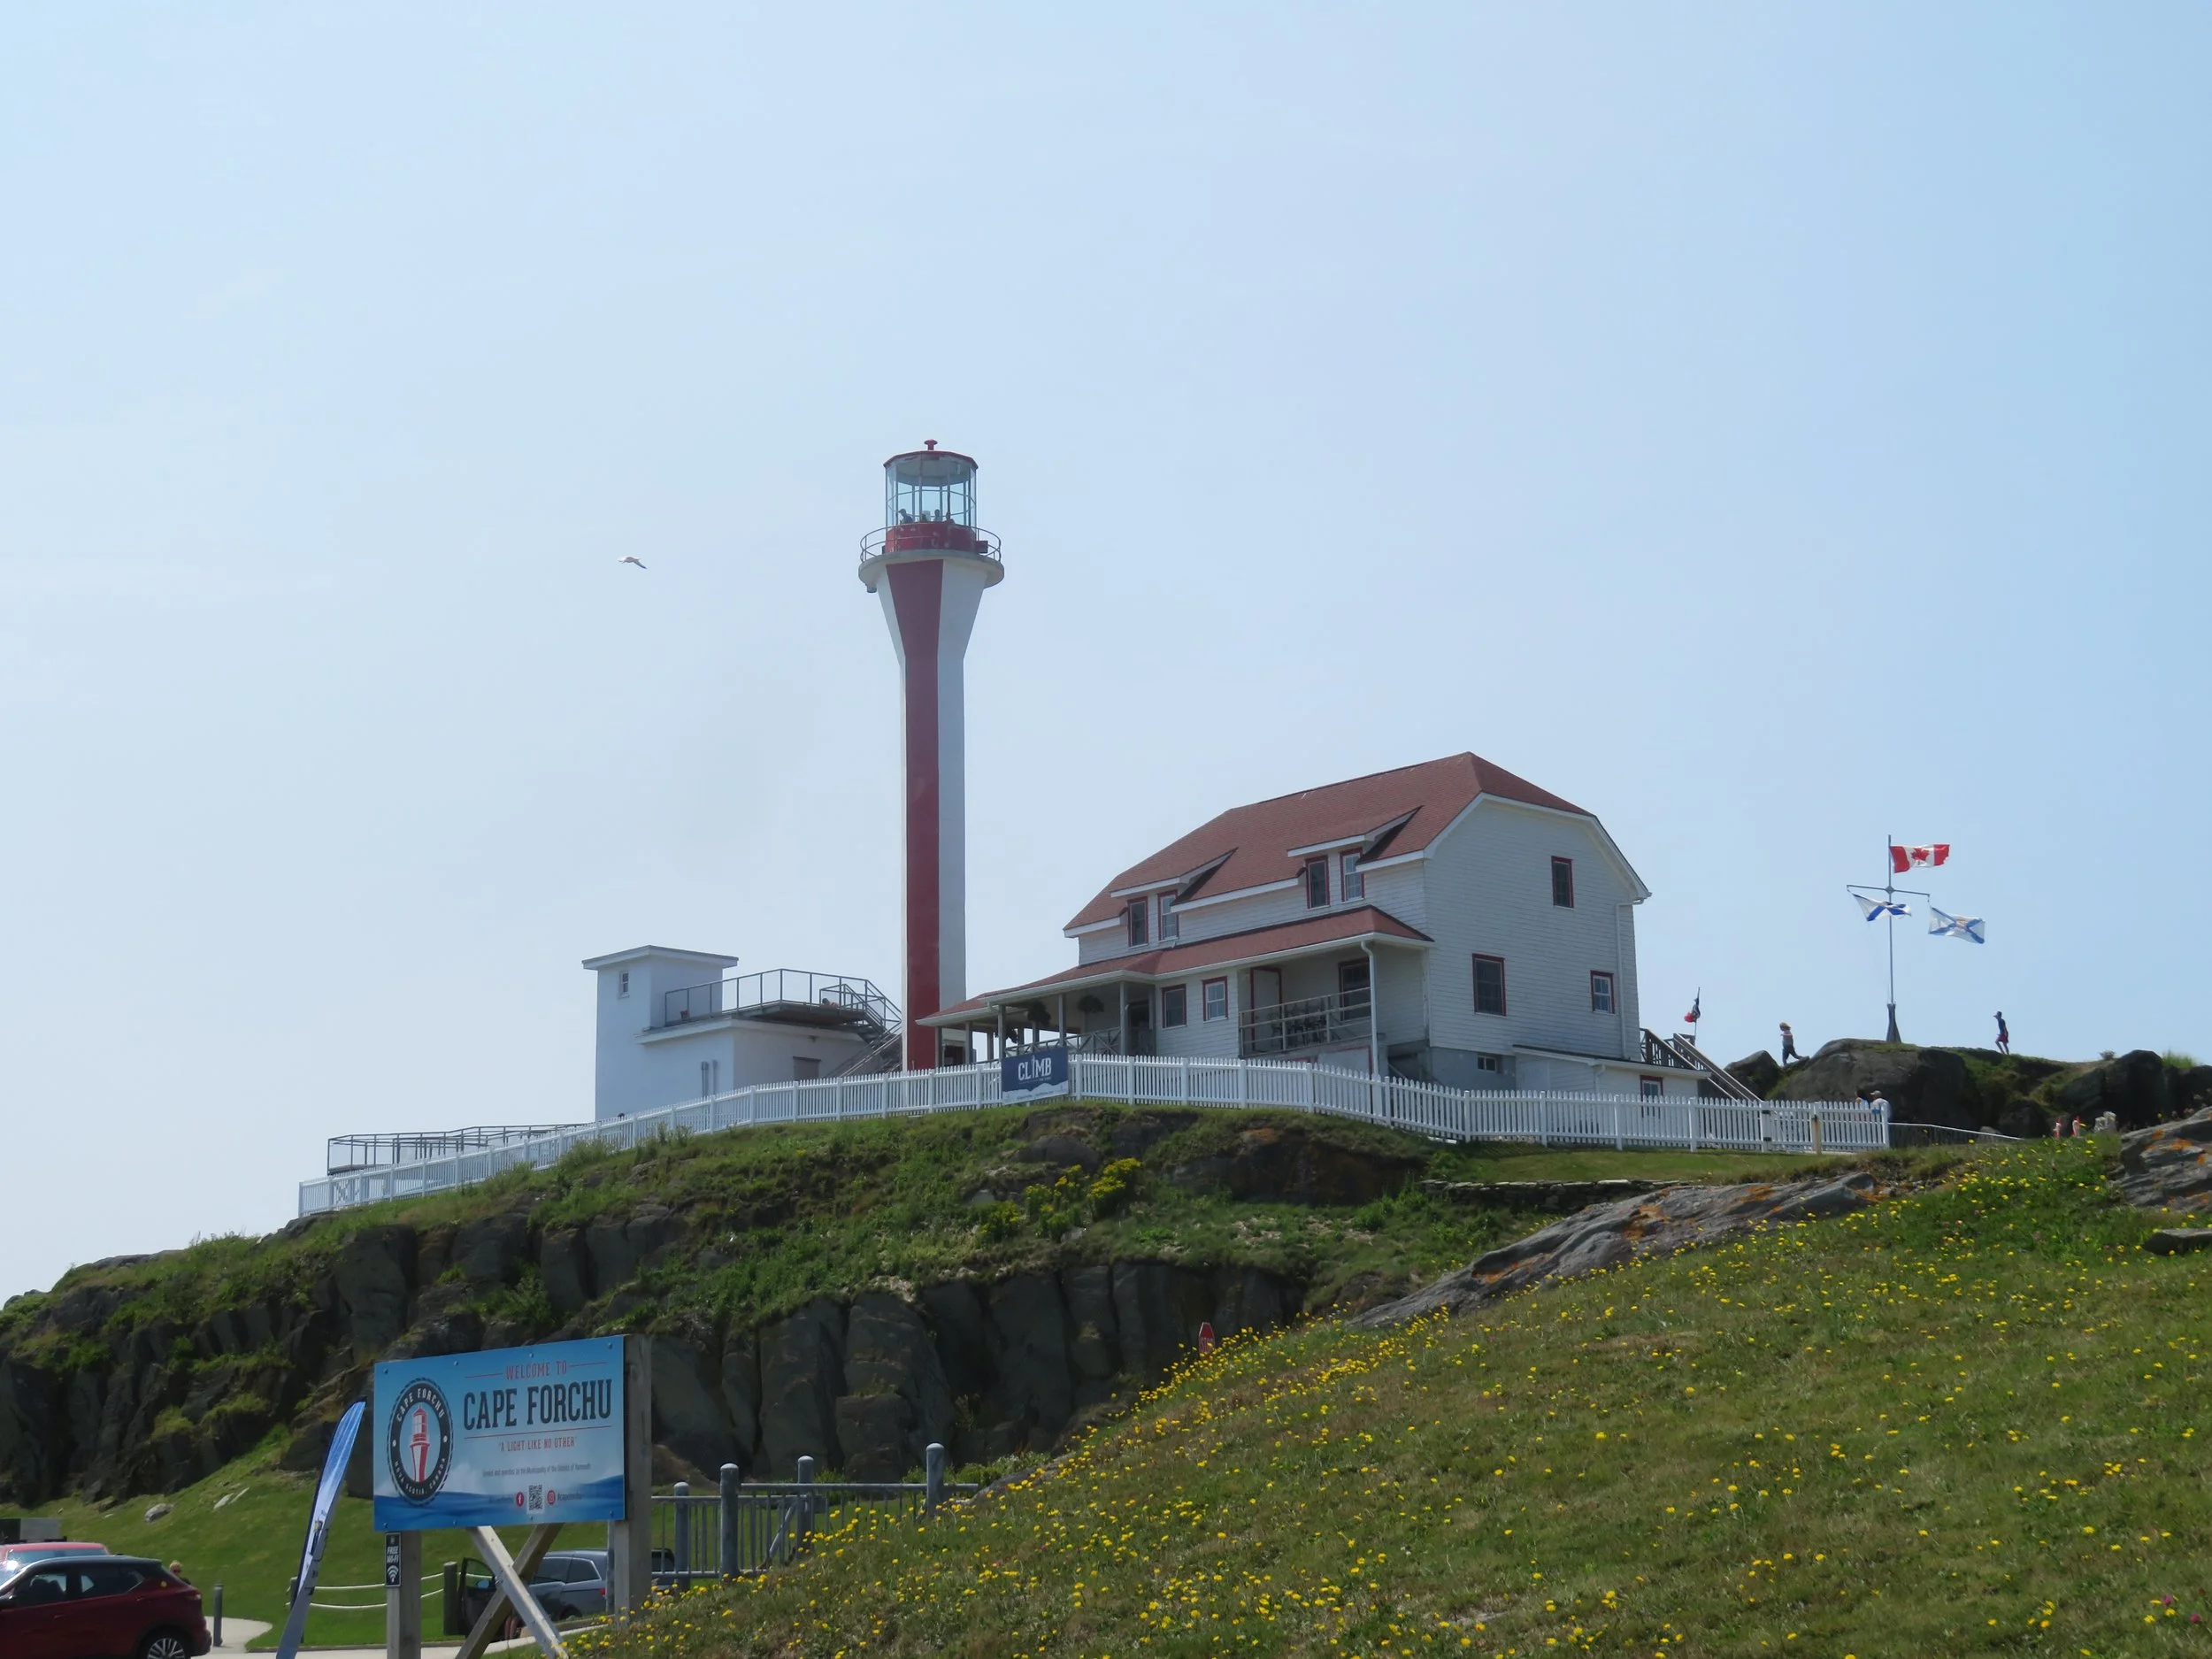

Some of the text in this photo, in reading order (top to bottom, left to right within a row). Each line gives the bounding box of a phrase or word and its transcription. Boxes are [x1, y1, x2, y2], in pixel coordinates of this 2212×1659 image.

[1018, 1055, 1051, 1081] CLIMB
[506, 1360, 567, 1379] WELCOME TO
[396, 1387, 445, 1422] CAPE FORCHU
[464, 1379, 612, 1431] CAPE FORCHU
[507, 1440, 525, 1452] LIGHT
[527, 1439, 541, 1450] LIKE
[543, 1438, 552, 1448] NO
[395, 1459, 404, 1483] NOVA
[429, 1458, 445, 1489] CANADA
[387, 1546, 399, 1555] FREE
